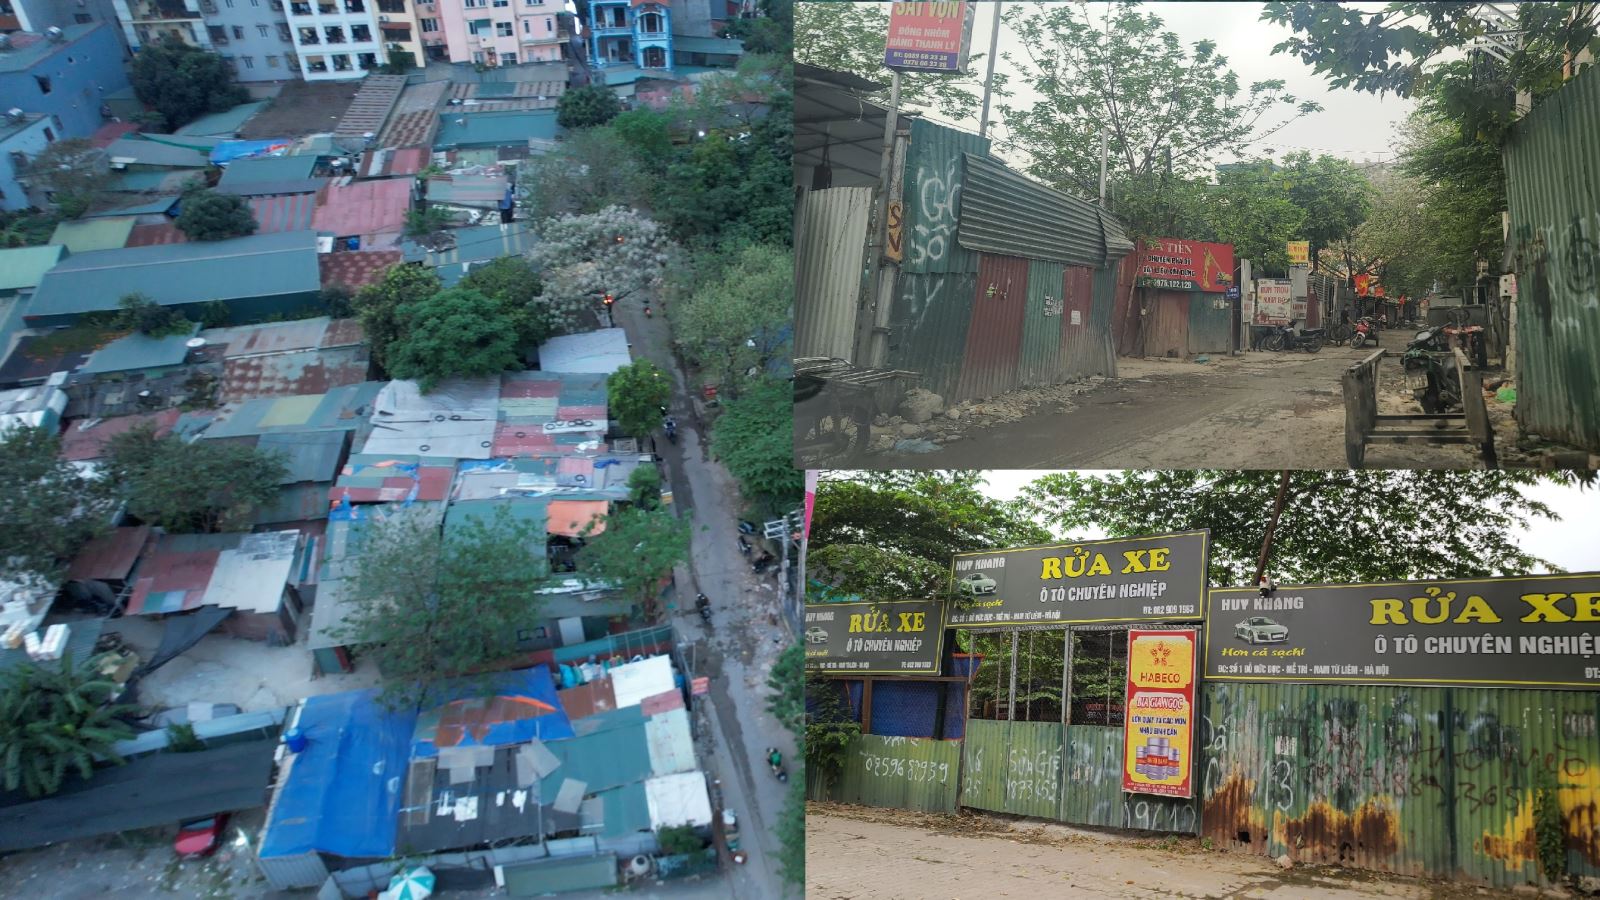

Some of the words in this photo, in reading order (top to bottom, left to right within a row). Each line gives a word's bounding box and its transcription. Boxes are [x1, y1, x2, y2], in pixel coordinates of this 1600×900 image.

[975, 557, 1006, 570] KHANG
[1041, 547, 1112, 580] RỬA
[1121, 547, 1171, 574] XE
[1040, 586, 1048, 603] Ô
[1051, 585, 1065, 602] TÔ
[1068, 583, 1116, 601] CHUYÊN
[1120, 580, 1167, 600] NGHIỆP
[1221, 599, 1249, 611] HUY
[1254, 597, 1304, 611] KHANG
[1369, 587, 1503, 625] RỬA
[1520, 592, 1600, 623] XE
[897, 612, 926, 632] XE
[864, 637, 893, 652] CHUYÊN
[894, 637, 922, 653] NGHIỆP
[1374, 634, 1387, 654] Ô
[1393, 634, 1418, 654] TÔ
[1424, 633, 1511, 654] CHUYÊN
[1140, 672, 1180, 684] HABECO
